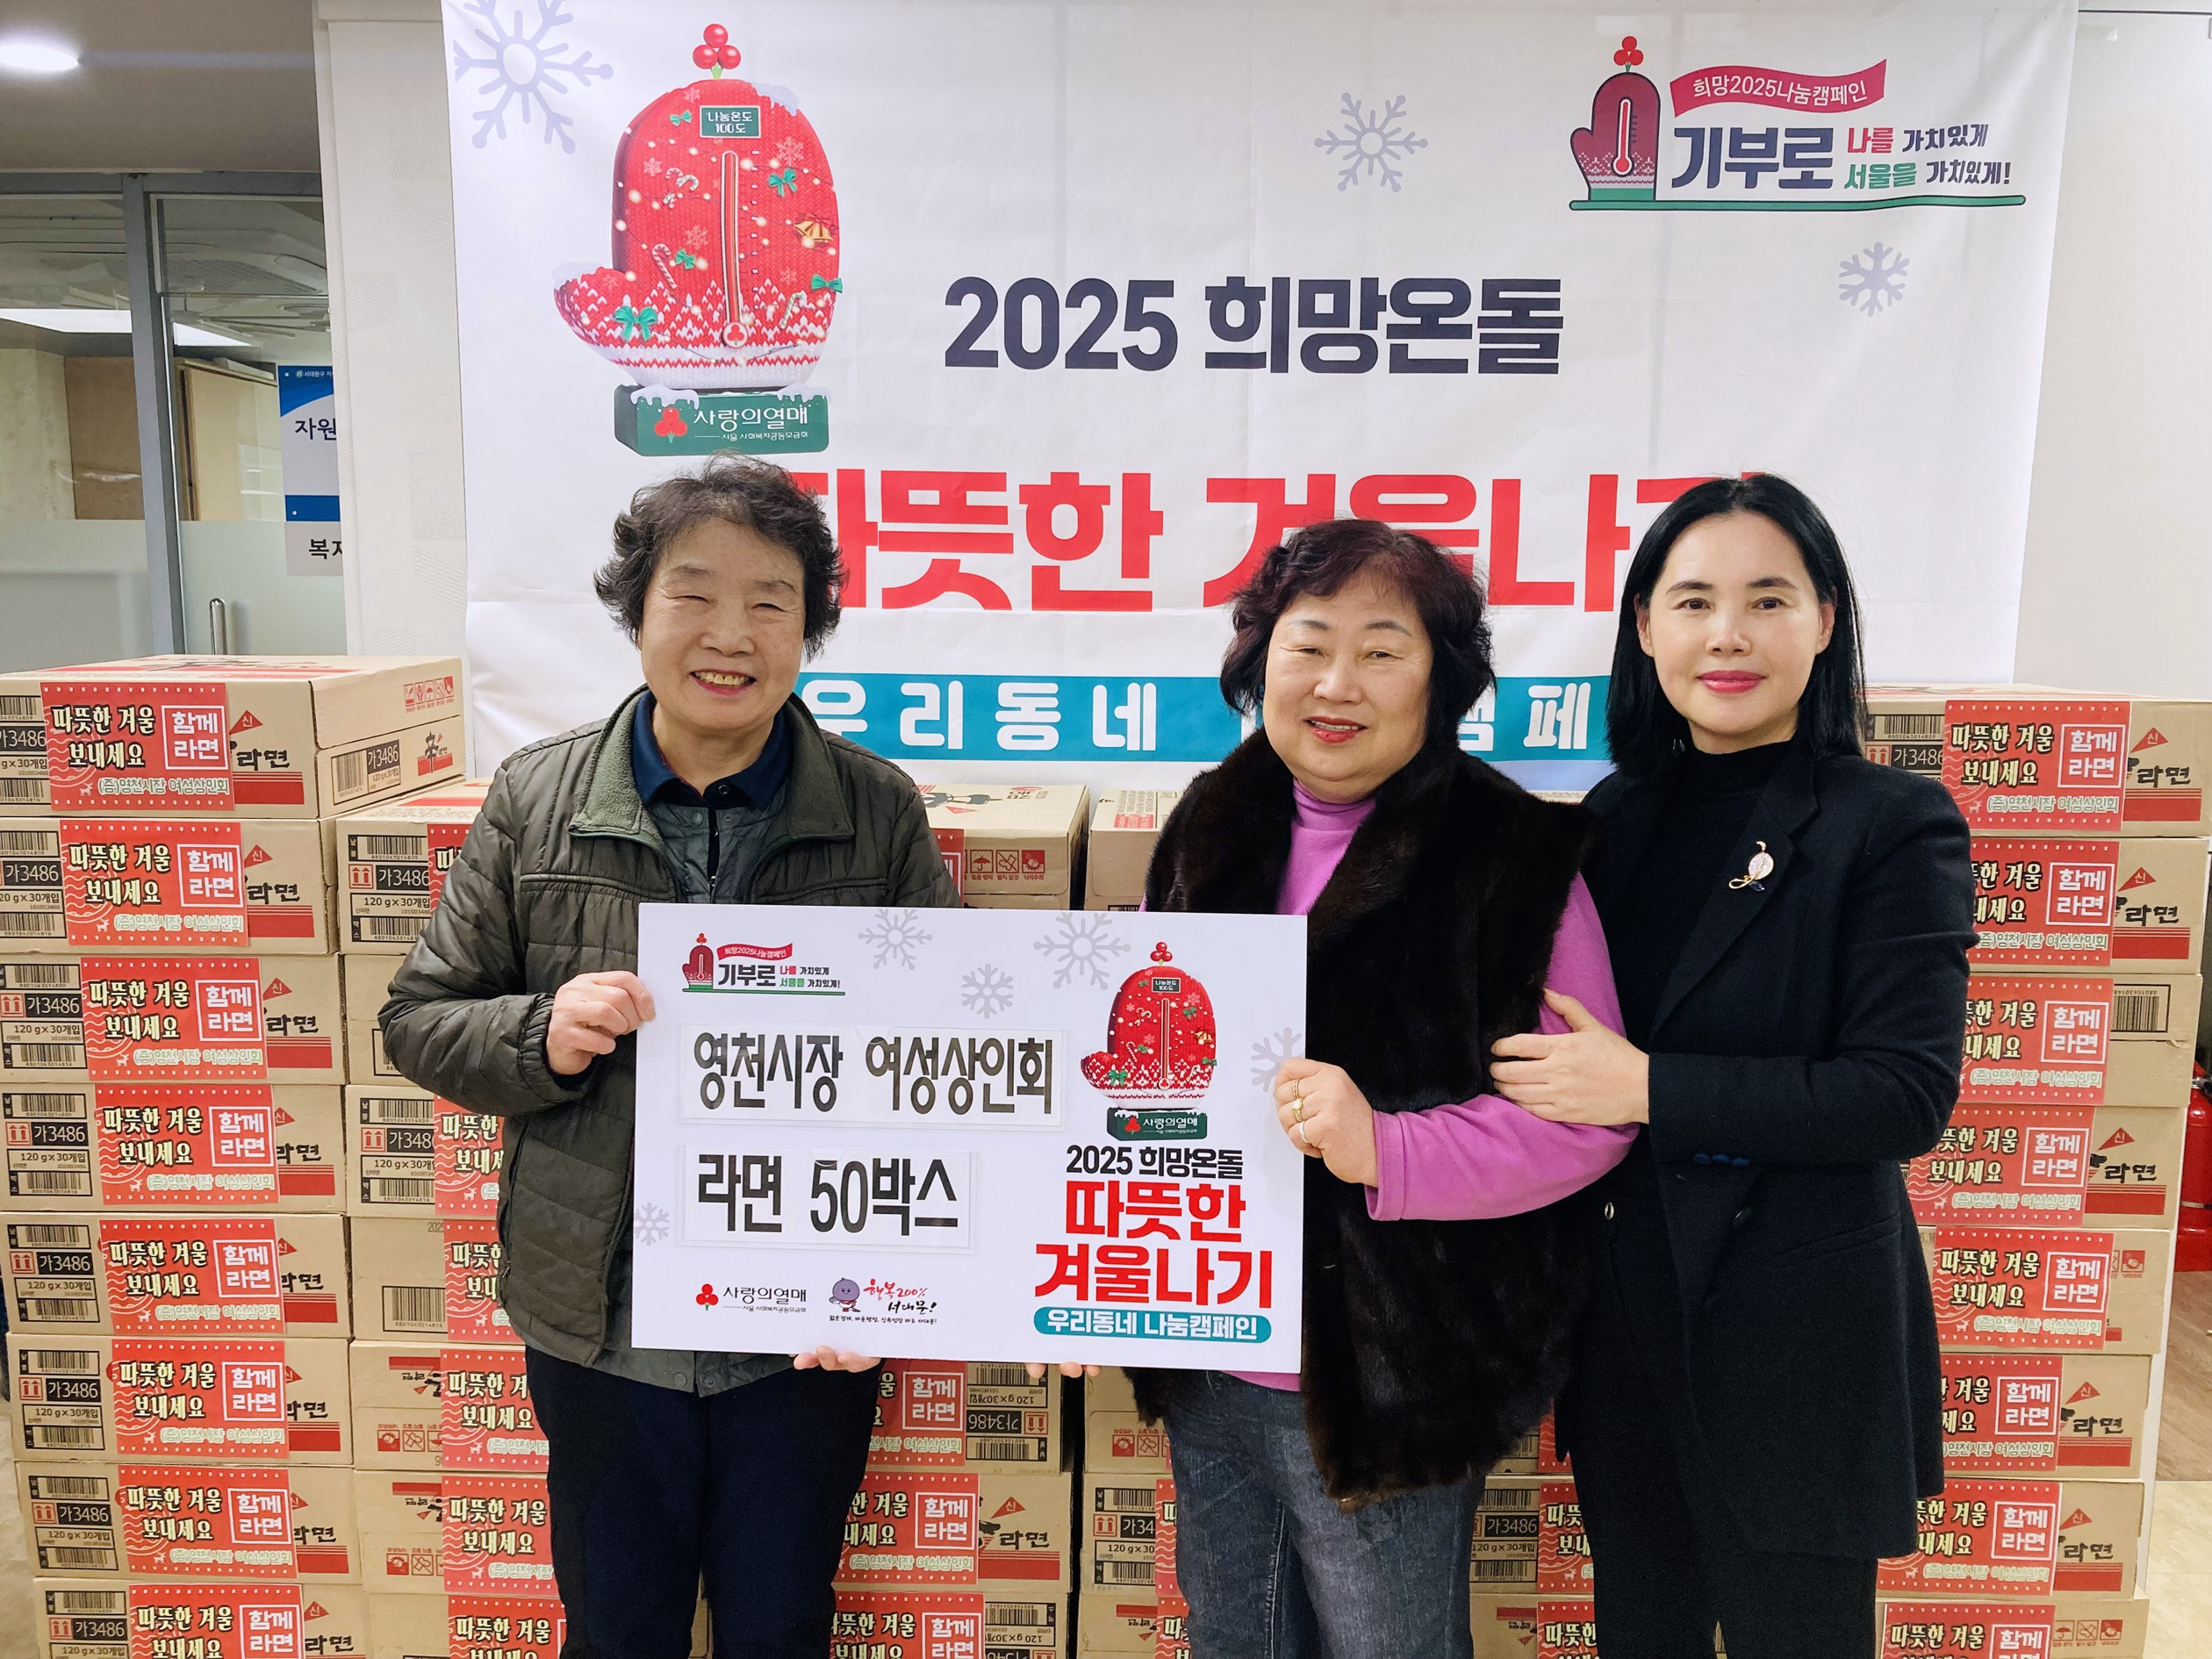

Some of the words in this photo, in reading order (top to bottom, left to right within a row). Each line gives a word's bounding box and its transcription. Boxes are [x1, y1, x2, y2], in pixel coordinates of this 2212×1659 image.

[1693, 79, 1866, 106] 희망2025나눔캠페인
[707, 111, 752, 123] 나눔온도
[715, 123, 746, 134] 100도
[1848, 127, 1893, 154] 나를
[1904, 124, 1988, 152] 가치있게
[1671, 127, 1833, 190] 기부로
[1844, 163, 1917, 190] 서울을
[1927, 161, 2010, 185] 가치있게!
[944, 278, 1180, 372] 2025
[1205, 276, 1562, 375] 희망온돌
[693, 407, 808, 432] 사랑의열매
[51, 704, 112, 735] 따뜻한
[118, 706, 155, 735] 겨울
[172, 712, 219, 734] 함께
[242, 715, 254, 728] 신
[1951, 723, 2009, 751] 따뜻한
[2147, 732, 2159, 744] 신
[68, 742, 146, 770] 보내세요
[173, 740, 220, 761] 라면
[368, 745, 399, 769] 가3486
[1962, 761, 2038, 787] 보내세요
[2069, 758, 2115, 779] 라면
[169, 778, 230, 795] 여성상인회
[2058, 796, 2119, 813] 여성상인회
[68, 843, 129, 873] 따뜻한
[134, 844, 172, 873] 겨울
[186, 850, 234, 873] 함께
[251, 850, 263, 862] 신
[5, 865, 59, 882] 가3486
[378, 868, 430, 887] 가3486
[2005, 863, 2042, 891] 겨울
[2059, 869, 2106, 890] 함께
[2135, 872, 2147, 884] 신
[85, 880, 162, 907] 보내세요
[189, 878, 236, 899] 라면
[364, 897, 382, 906] 120
[2057, 896, 2104, 916] 라면
[183, 915, 244, 934] 여성상인회
[2046, 934, 2108, 950] 여성상인회
[719, 965, 776, 987] 기부로
[780, 966, 796, 974] 나를
[800, 966, 829, 975] 가치있게
[90, 980, 147, 1008] 따뜻한
[272, 983, 284, 994] 신
[808, 979, 840, 988] 가치있게!
[27, 997, 79, 1014] 가3486
[104, 1016, 180, 1040] 보내세요
[208, 1012, 254, 1032] 라면
[2053, 1008, 2100, 1029] 함께
[2052, 1034, 2097, 1054] 라면
[693, 1031, 843, 1112] 영천시장
[865, 1036, 1053, 1115] 여성상인회
[2041, 1070, 2102, 1088] 여성상인회
[103, 1108, 160, 1135] 따뜻한
[167, 1108, 204, 1135] 겨울
[219, 1112, 264, 1133] 함께
[1143, 1117, 1197, 1129] 사랑의열매
[34, 1124, 86, 1143] 가3486
[1982, 1127, 2019, 1154] 겨울
[118, 1142, 193, 1167] 보내세요
[220, 1138, 265, 1158] 라면
[1066, 1146, 1133, 1175] 2025
[1138, 1148, 1243, 1180] 희망온돌
[2033, 1160, 2078, 1178] 라면
[698, 1153, 782, 1232] 라면
[811, 1158, 958, 1236] 50박스
[2022, 1195, 2081, 1210] 여성상인회
[1066, 1181, 1246, 1242] 따뜻한
[40, 1255, 90, 1272] 가3486
[110, 1241, 166, 1268] 따뜻한
[223, 1246, 269, 1266] 함께
[2003, 1250, 2040, 1278] 겨울
[226, 1270, 270, 1289] 라면
[1035, 1243, 1272, 1308] 겨울나기
[2056, 1259, 2100, 1280] 함께
[126, 1275, 200, 1298] 보내세요
[723, 1287, 807, 1304] 사랑의열매
[2053, 1283, 2098, 1304] 라면
[887, 1301, 937, 1314] 서대문!
[1047, 1311, 1138, 1336] 우리동네
[1144, 1312, 1257, 1340] 나눔캠페인
[119, 1361, 175, 1389] 따뜻한
[182, 1362, 216, 1389] 겨울
[47, 1381, 98, 1398] 가3486
[2007, 1382, 2050, 1403] 함께
[233, 1394, 277, 1413] 라면
[461, 1405, 534, 1432] 보내세요
[968, 1414, 1018, 1430] 가3486
[2005, 1408, 2049, 1426] 라면
[1994, 1443, 2054, 1457] 여성상인회
[126, 1487, 182, 1512] 따뜻한
[188, 1488, 223, 1513] 겨울
[237, 1494, 283, 1514] 함께
[873, 1492, 908, 1518] 겨울
[924, 1497, 968, 1519] 함께
[1004, 1500, 1017, 1512] 신
[58, 1505, 110, 1523] 가3486
[449, 1498, 505, 1526] 따뜻한
[511, 1498, 547, 1526] 겨울
[1952, 1501, 1987, 1526] 겨울
[141, 1519, 213, 1542] 보내세요
[239, 1518, 284, 1536] 라면
[924, 1522, 967, 1541] 라면
[463, 1530, 535, 1555] 보내세요
[1108, 1544, 1126, 1553] 120
[75, 1621, 125, 1638] 가3486
[137, 1606, 193, 1632] 따뜻한
[248, 1610, 294, 1630] 함께
[456, 1616, 510, 1643] 따뜻한
[880, 1612, 916, 1639] 겨울
[931, 1618, 974, 1638] 함께
[250, 1633, 294, 1653] 라면
